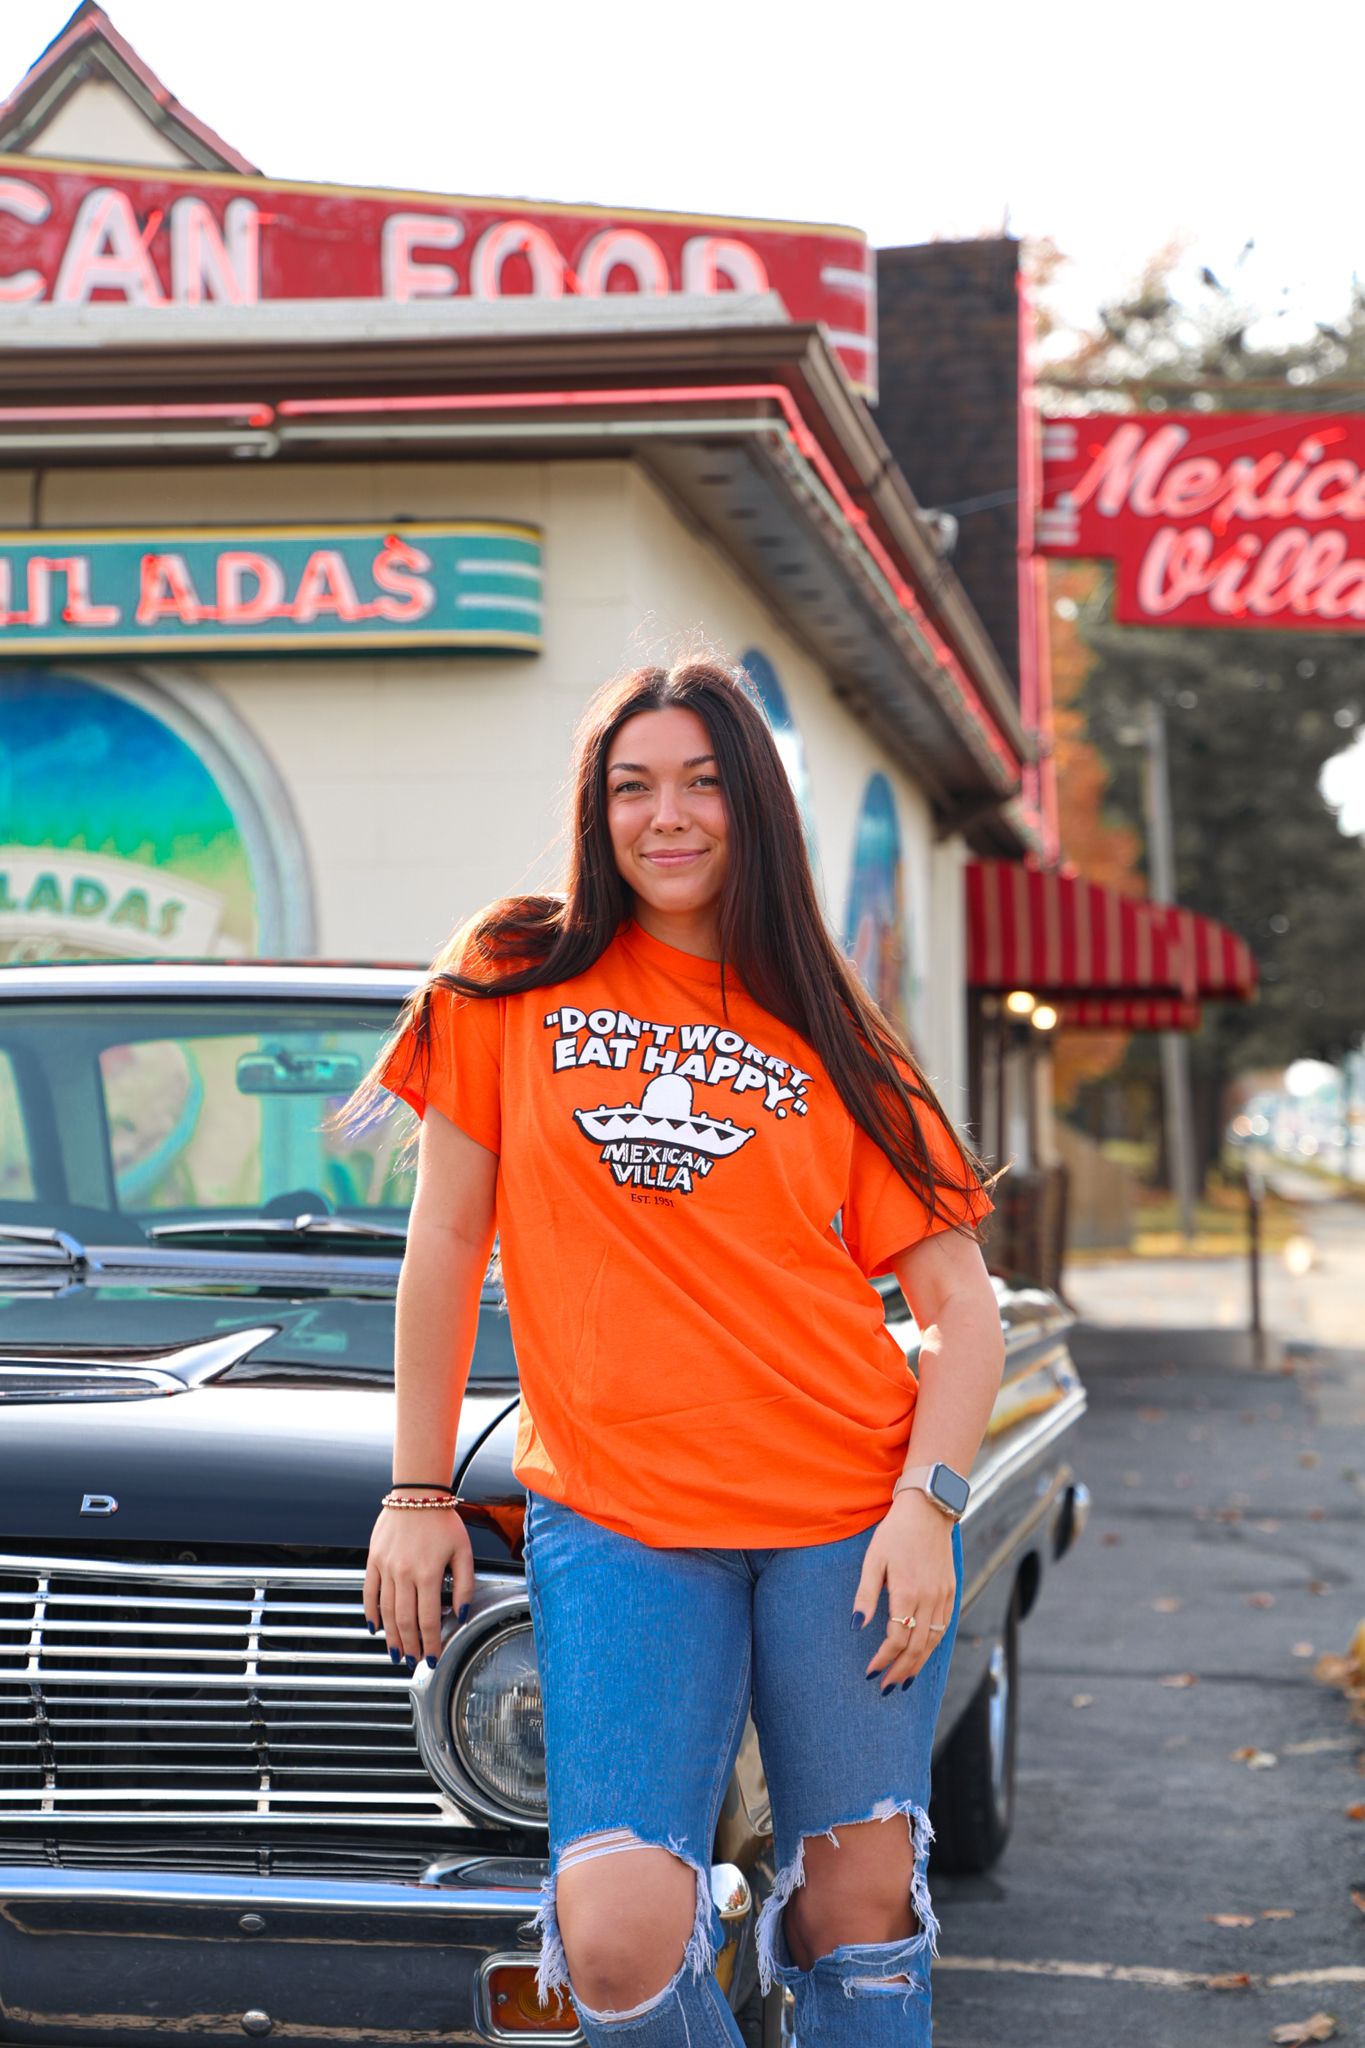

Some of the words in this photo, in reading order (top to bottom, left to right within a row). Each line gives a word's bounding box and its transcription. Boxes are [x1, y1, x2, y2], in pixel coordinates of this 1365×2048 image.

[382, 212, 770, 303] FOOD
[0, 545, 435, 628] ILADAS
[554, 1036, 637, 1073] EAT
[601, 1143, 714, 1177] MEXICAN
[610, 1163, 693, 1194] VILLA
[631, 1193, 651, 1205] EST.
[654, 1195, 674, 1208] 1951
[80, 1494, 118, 1517] D
